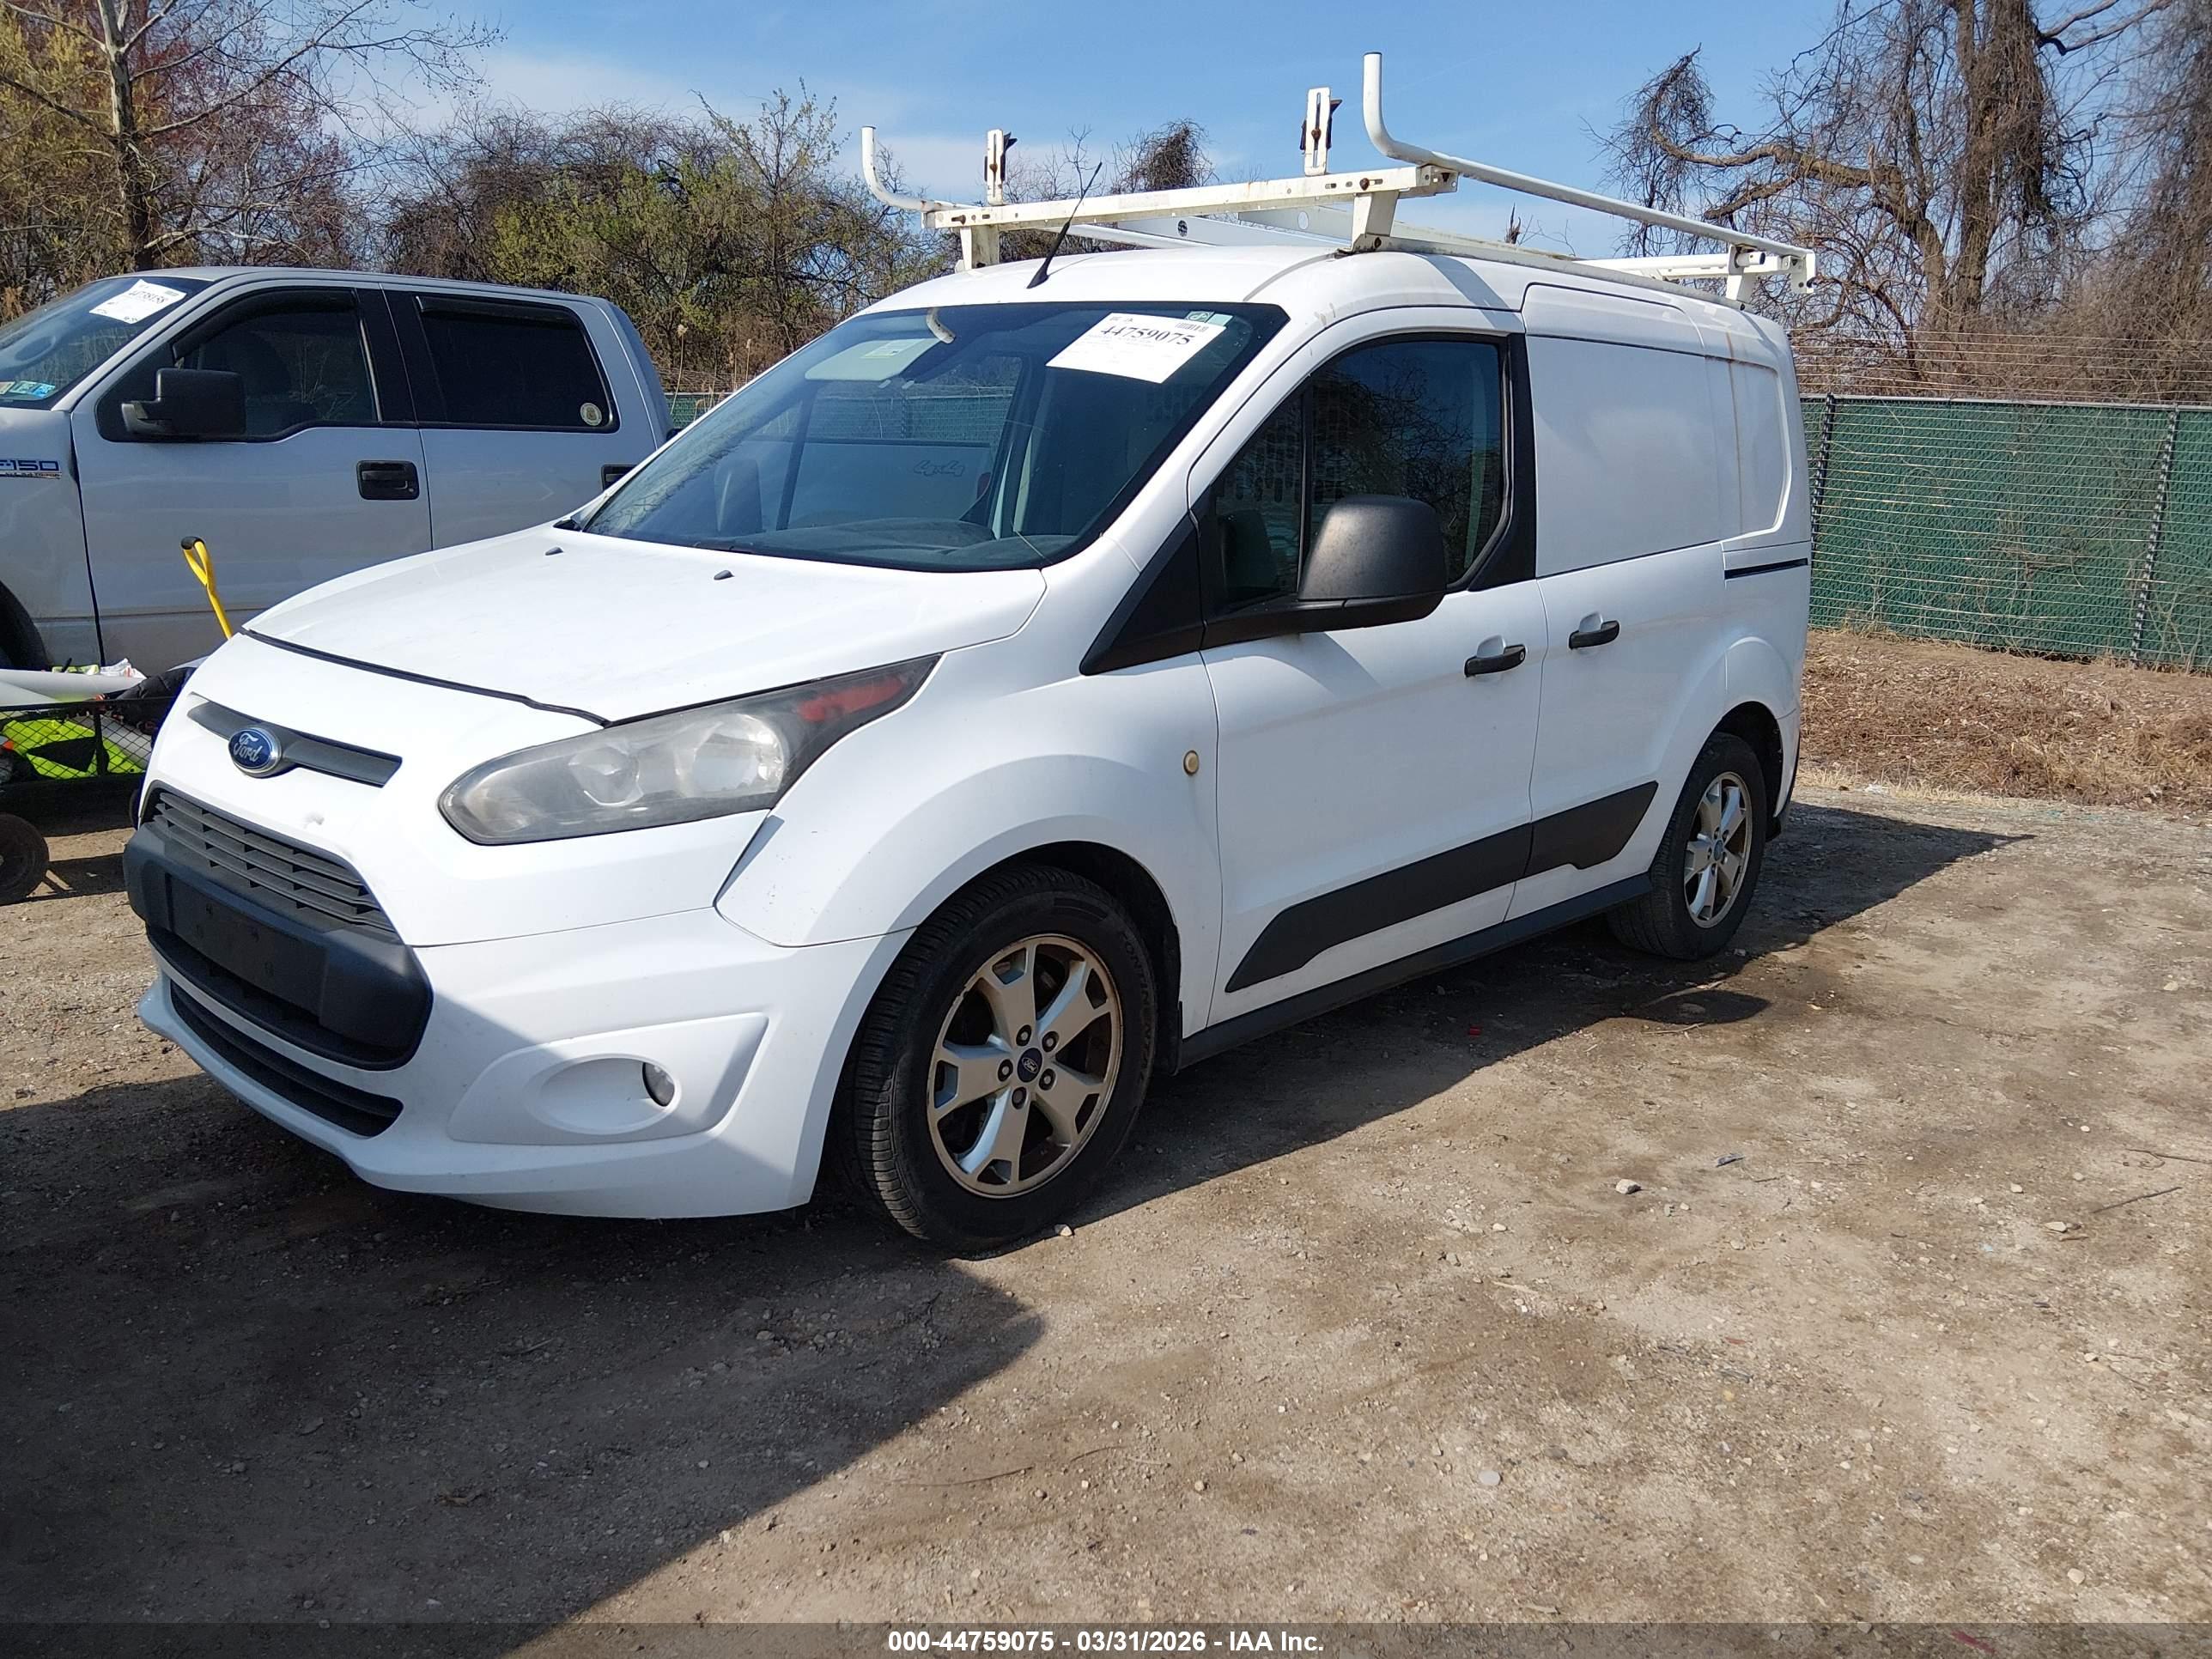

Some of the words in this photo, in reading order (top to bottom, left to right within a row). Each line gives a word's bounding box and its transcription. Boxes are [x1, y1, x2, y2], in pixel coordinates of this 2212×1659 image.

[1100, 325, 1196, 345] 44759075
[913, 459, 966, 477] 4x4
[233, 732, 264, 763] Ford
